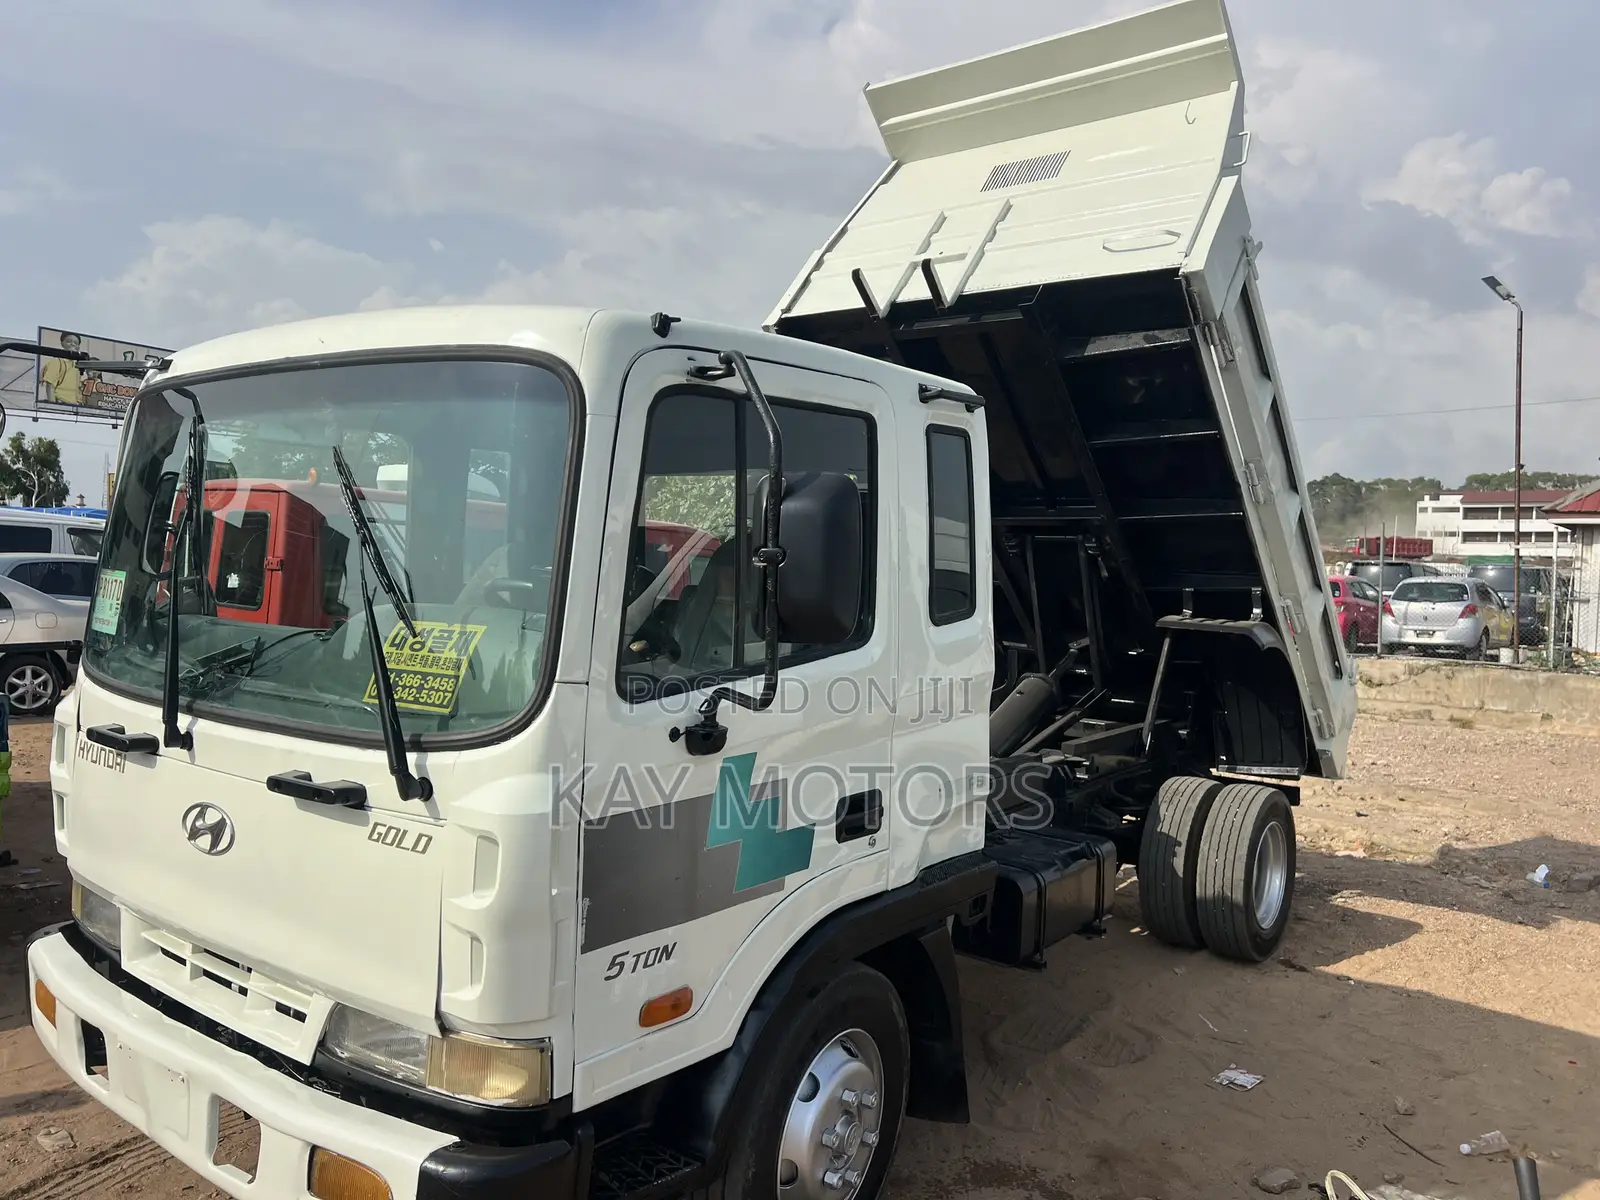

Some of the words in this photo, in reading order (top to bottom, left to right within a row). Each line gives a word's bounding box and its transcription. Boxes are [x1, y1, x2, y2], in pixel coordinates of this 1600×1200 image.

[389, 626, 477, 657] 대성골재
[370, 684, 452, 706] 0-342-5307
[388, 672, 456, 692] 1-366-3458
[77, 738, 127, 773] HYUNDAI
[368, 821, 433, 855] GOLD
[603, 950, 630, 982] 5
[630, 942, 678, 975] TON
